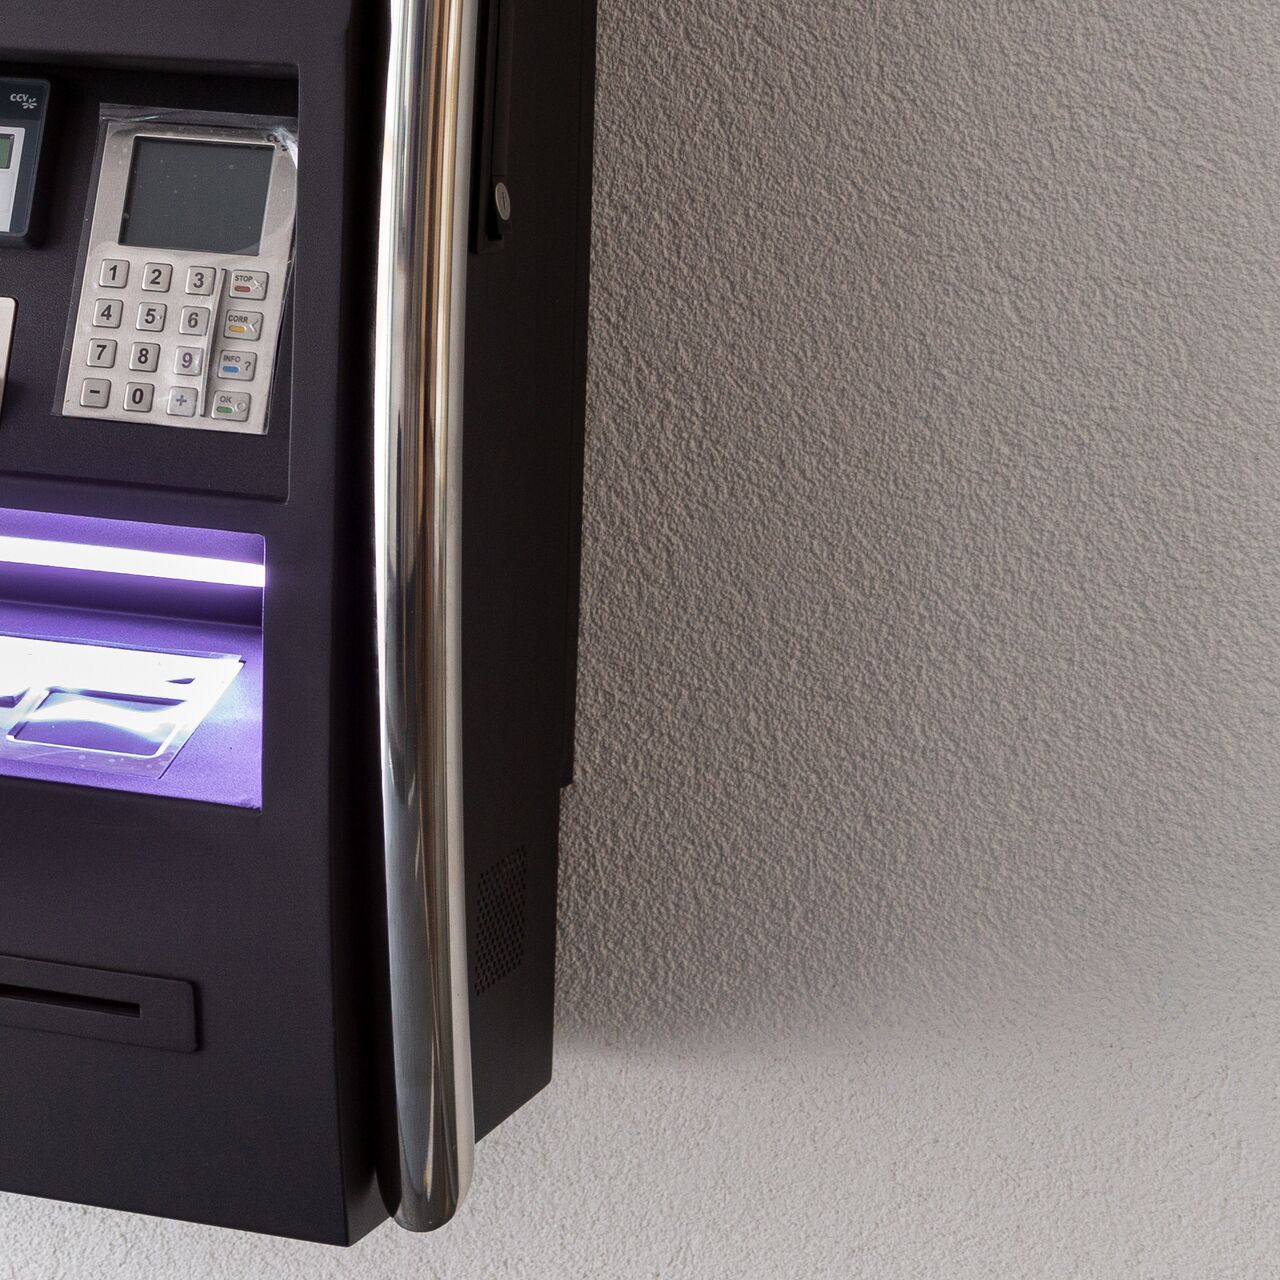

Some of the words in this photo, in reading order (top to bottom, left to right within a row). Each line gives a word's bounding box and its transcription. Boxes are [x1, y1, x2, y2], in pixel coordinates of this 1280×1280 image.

[10, 93, 29, 101] CCV
[109, 264, 118, 281] 1
[149, 268, 162, 285] 2
[192, 272, 204, 289] 3
[234, 274, 253, 282] STOP
[100, 304, 113, 321] 4
[144, 308, 156, 324] 5
[187, 312, 199, 329] 6
[228, 314, 249, 323] CORR
[95, 344, 107, 361] 7
[137, 347, 150, 364] 8
[181, 352, 194, 368] 9
[223, 355, 241, 363] INFO
[131, 388, 144, 405] 0
[220, 395, 232, 403] OK
